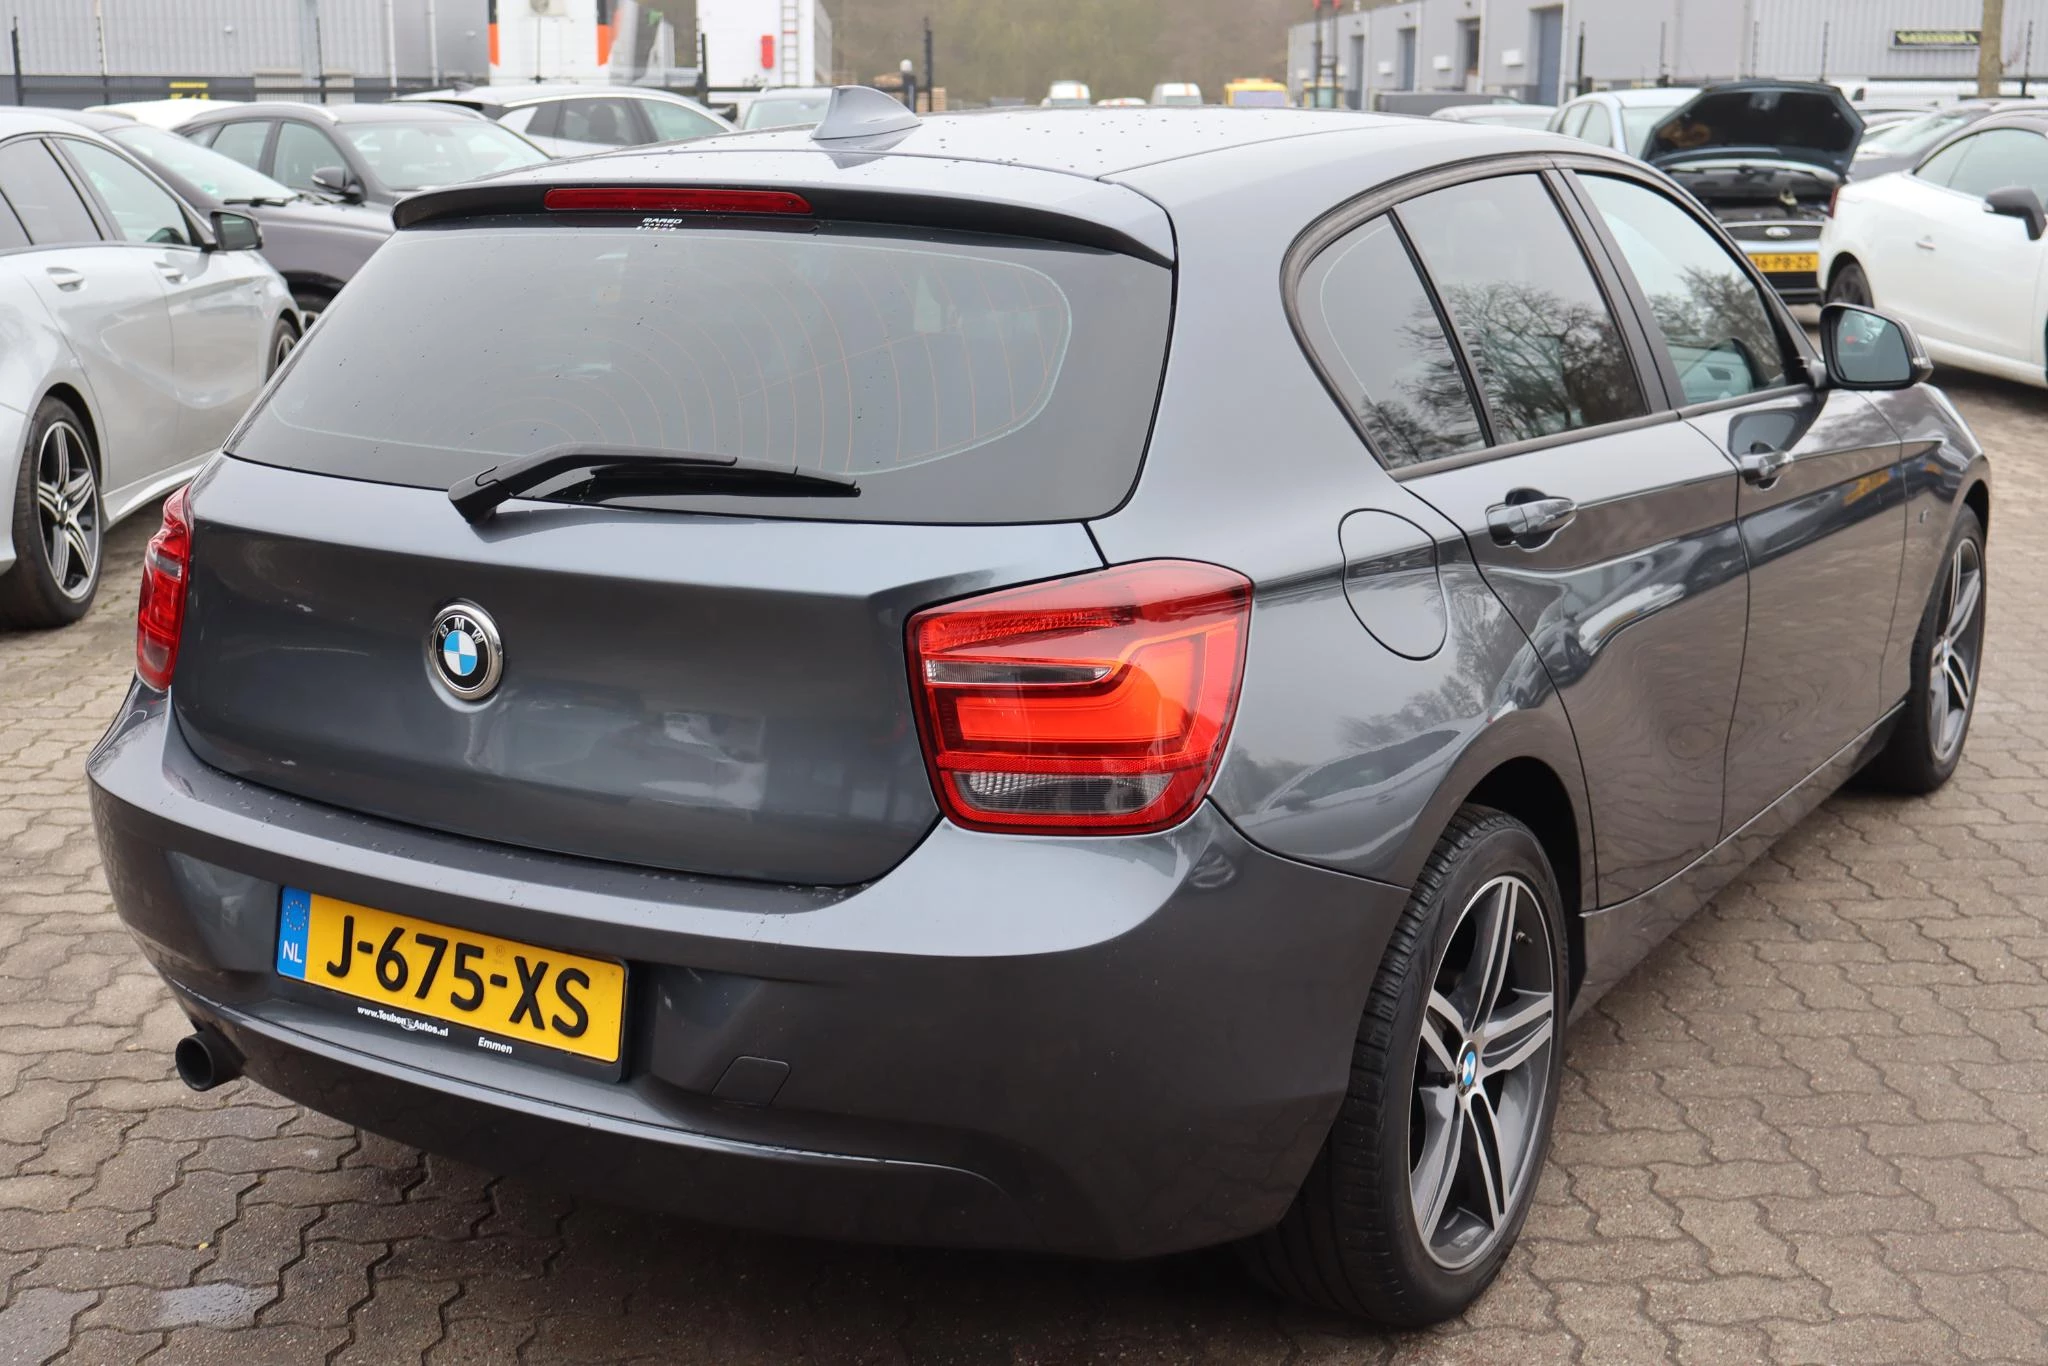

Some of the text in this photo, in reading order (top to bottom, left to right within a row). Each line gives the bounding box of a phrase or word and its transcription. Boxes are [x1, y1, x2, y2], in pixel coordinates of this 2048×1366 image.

[440, 617, 484, 645] BMW
[282, 941, 303, 964] NL
[326, 914, 591, 1039] J-675-XS
[477, 1036, 513, 1055] Emmen
